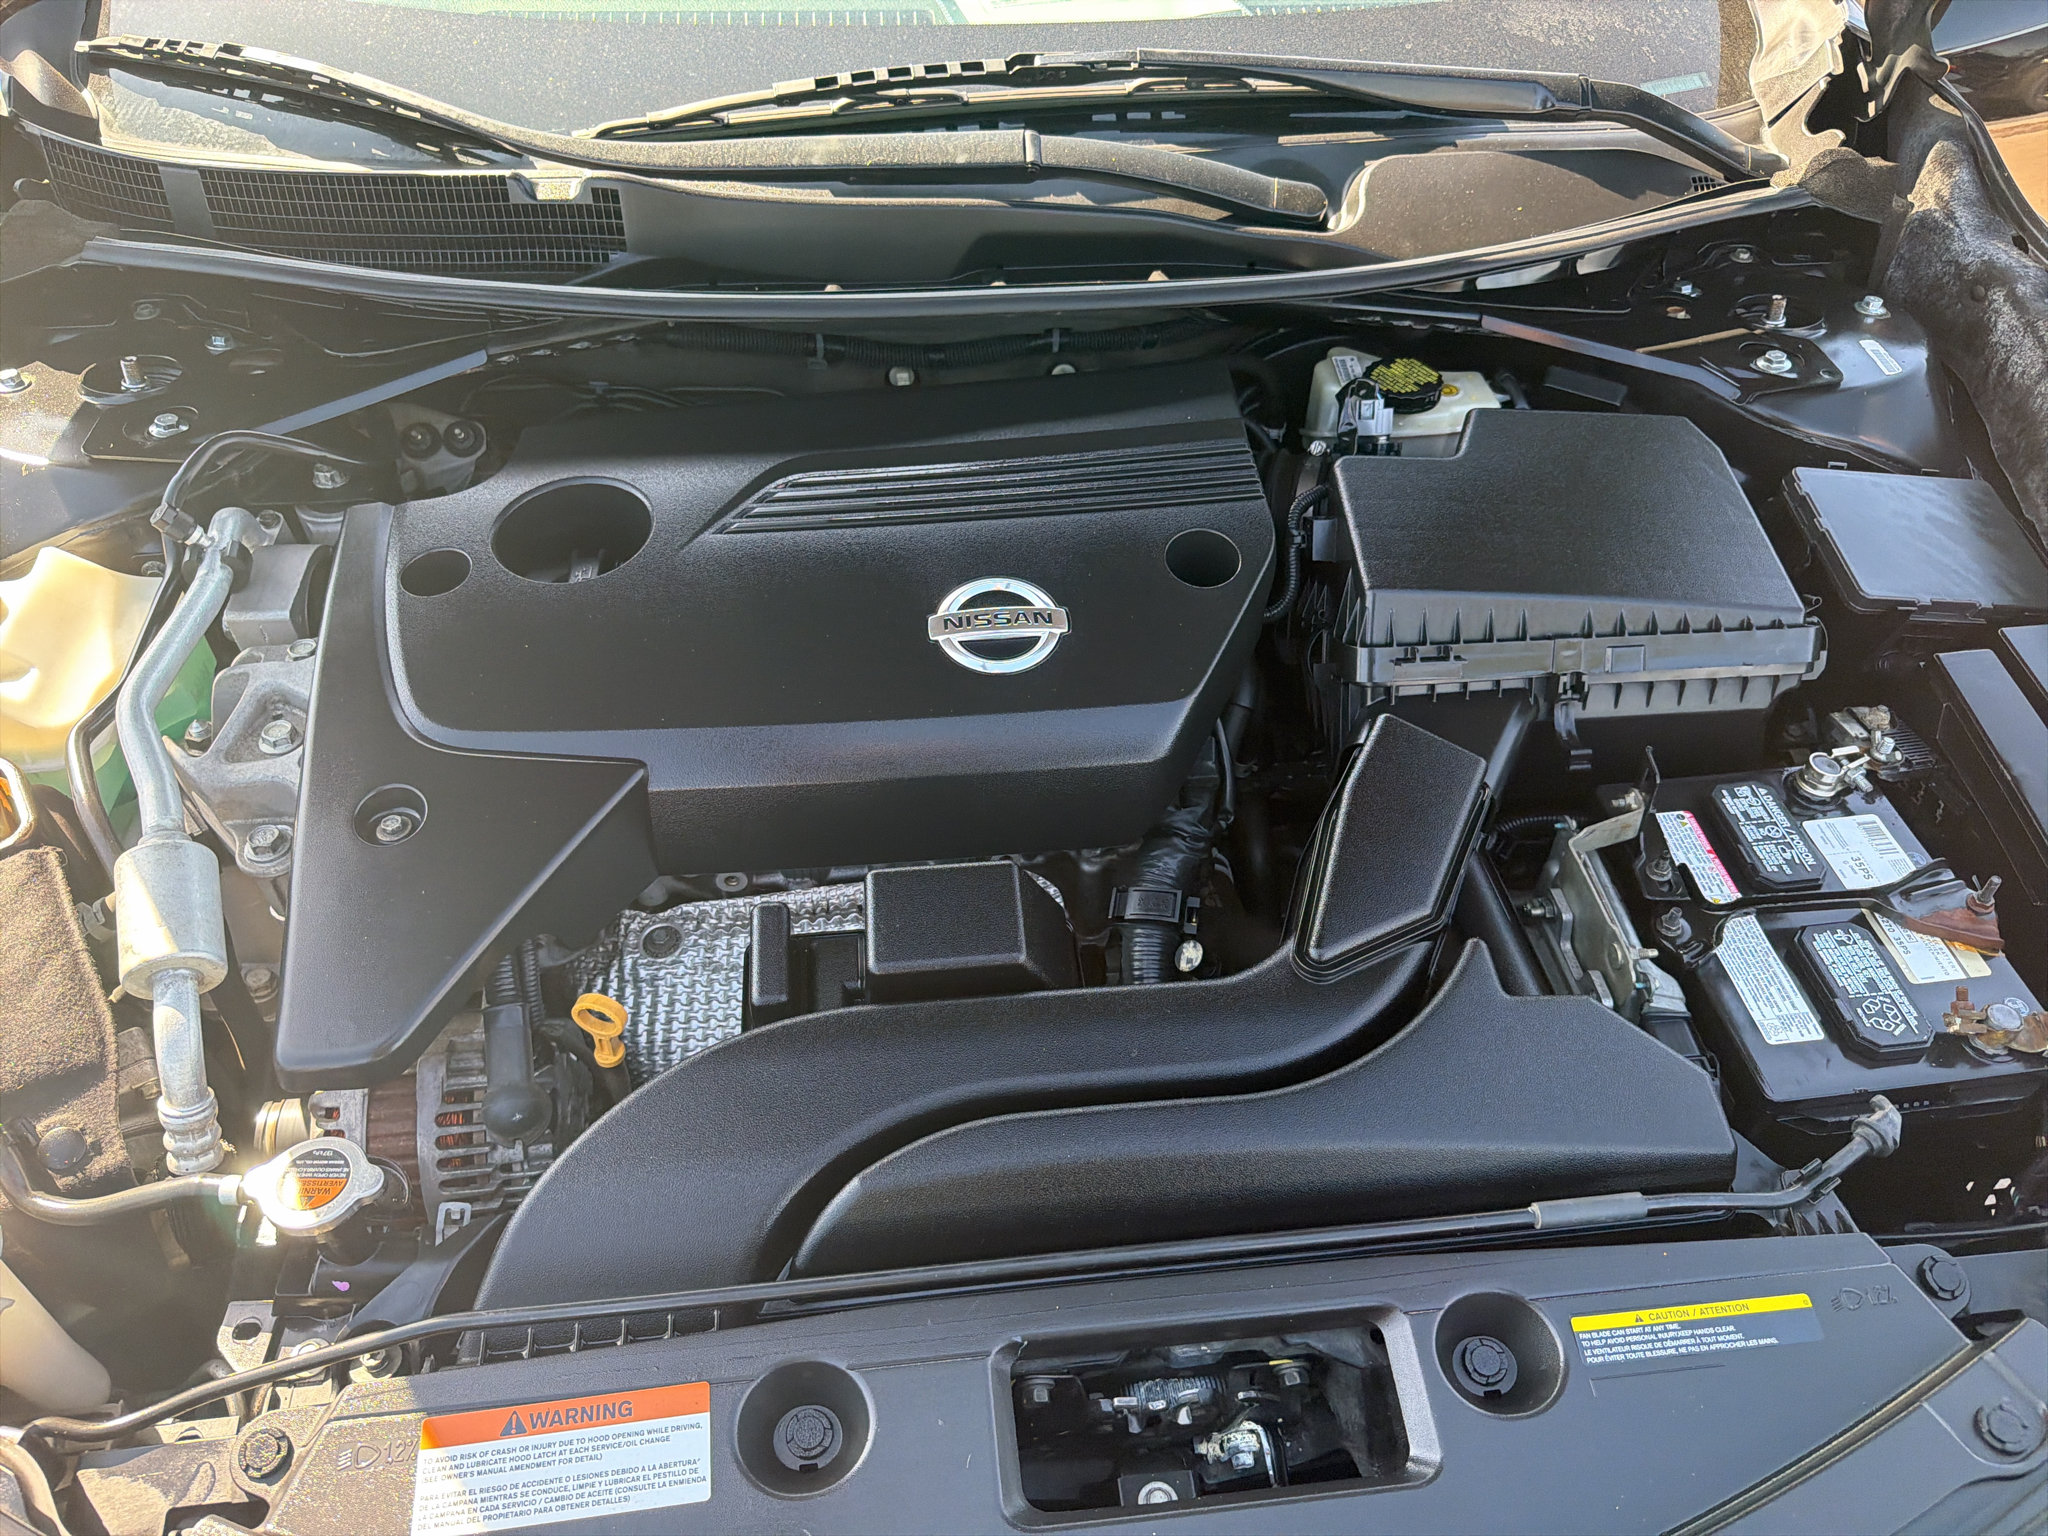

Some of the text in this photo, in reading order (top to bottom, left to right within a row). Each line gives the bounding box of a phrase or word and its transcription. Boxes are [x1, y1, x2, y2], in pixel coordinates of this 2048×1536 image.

[943, 611, 1053, 631] NISSAN
[1763, 795, 1790, 826] DANGER
[1789, 834, 1815, 864] POISON
[1850, 856, 1873, 879] 35PS
[1893, 937, 1911, 954] 35PS
[1648, 1309, 1689, 1320] CAUTION
[1699, 1303, 1749, 1315] ATTENTION
[1592, 1345, 1630, 1354] VENTILATEUR
[1709, 1341, 1745, 1349] APPROCHER
[530, 1401, 633, 1430] WARNING
[435, 1454, 457, 1463] AVOID
[459, 1452, 477, 1460] RISK
[490, 1446, 516, 1455] CRASH
[531, 1441, 556, 1450] INJURY
[558, 1439, 574, 1447] DUE
[588, 1434, 609, 1443] HOOD
[611, 1429, 644, 1440] OPENING
[646, 1426, 668, 1435] WHILE
[671, 1422, 702, 1432] DRIVING,
[448, 1462, 464, 1470] AND
[466, 1457, 506, 1468] LUBRICATE
[509, 1453, 531, 1462] HOOD
[533, 1450, 556, 1459] LATCH
[569, 1446, 589, 1454] EACH
[591, 1439, 637, 1451] SERVICE/OIL
[639, 1435, 670, 1445] CHANGE
[441, 1470, 474, 1481] OWNER'S
[476, 1466, 507, 1476] MANUAL
[509, 1459, 555, 1472] AMENDMENT
[558, 1457, 572, 1465] FOR
[575, 1453, 602, 1463] DETAIL)
[441, 1489, 466, 1498] EVITAR
[479, 1484, 507, 1493] RIESGO
[521, 1476, 563, 1488] ACCIDENTE
[573, 1470, 608, 1481] LESIONES
[611, 1466, 638, 1476] DEBIDO
[442, 1497, 478, 1508] CAMPANA
[480, 1491, 517, 1503] MIENTRAS
[531, 1484, 570, 1496] CONDUCE,
[572, 1481, 596, 1490] LIMPIE
[604, 1475, 640, 1486] LUBRICAR
[653, 1469, 686, 1479] PESTILLO
[689, 1467, 698, 1475] DE
[429, 1508, 465, 1519] CAMPANA
[467, 1506, 477, 1514] EN
[479, 1503, 499, 1512] CADA
[501, 1498, 535, 1509] SERVICIO
[544, 1493, 573, 1503] CAMBIO
[587, 1488, 612, 1497] ACEITE
[615, 1482, 655, 1494] (CONSULTE
[668, 1475, 706, 1486] ENMIENDA
[466, 1515, 480, 1523] DEL
[482, 1508, 531, 1521] PROPIETARIO
[534, 1506, 552, 1514] PARA
[555, 1501, 589, 1511] OBTENER
[591, 1495, 630, 1506] DETALLES)
